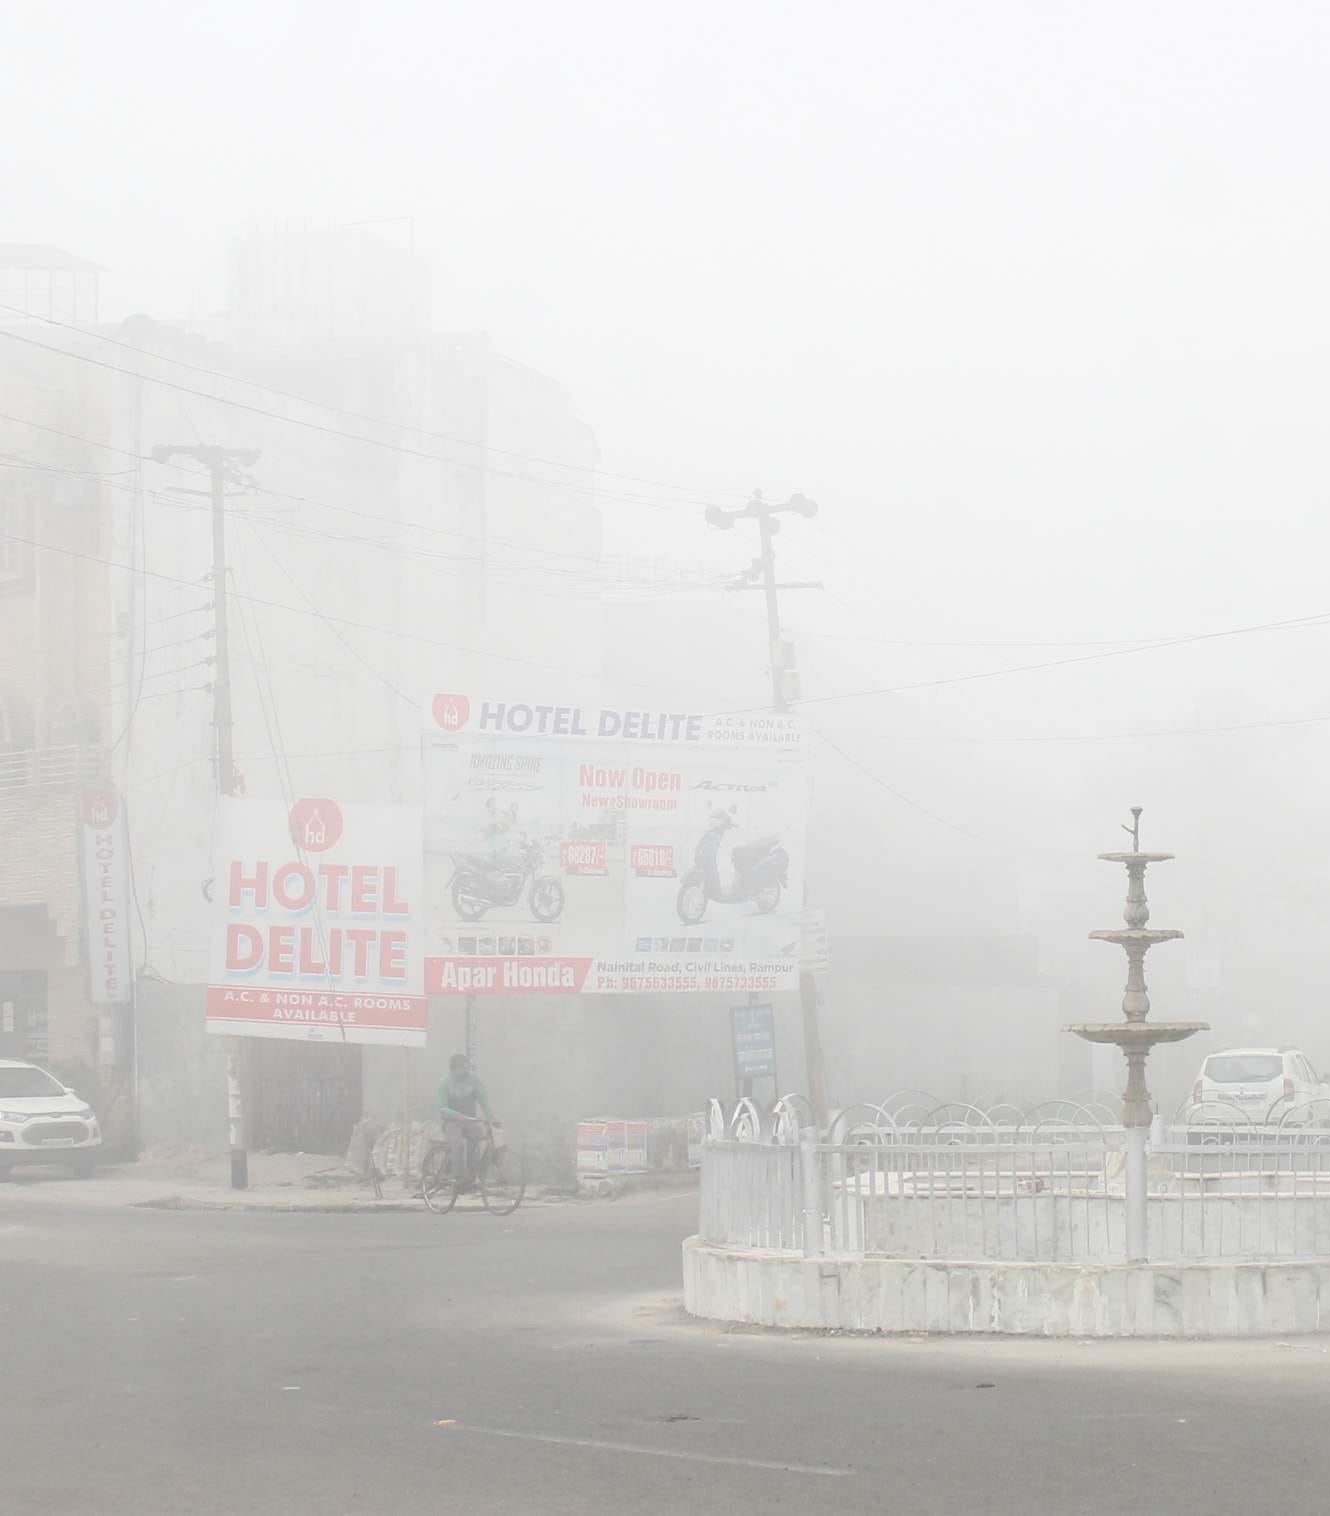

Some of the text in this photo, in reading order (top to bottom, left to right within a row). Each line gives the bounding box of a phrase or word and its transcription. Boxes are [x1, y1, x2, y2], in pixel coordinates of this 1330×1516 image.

[479, 702, 703, 741] HOTEL DELITE
[749, 719, 774, 729] NON
[707, 730, 801, 744] ROOMS AVAILABLE
[579, 764, 682, 791] Now Open
[582, 794, 678, 811] New Showroom
[304, 825, 326, 844] hd
[228, 860, 410, 916] HOTEL
[95, 832, 119, 991] HOTEL DELITE
[224, 923, 409, 980] DELITE
[441, 961, 576, 989] Apar Honda
[597, 961, 794, 976] Nainital Road, Civil Lines, Rampur
[597, 976, 617, 989] Ph:
[224, 991, 411, 1010] A.C. & NON A.C. ROOMS
[272, 1008, 357, 1023] AVAILABLE
